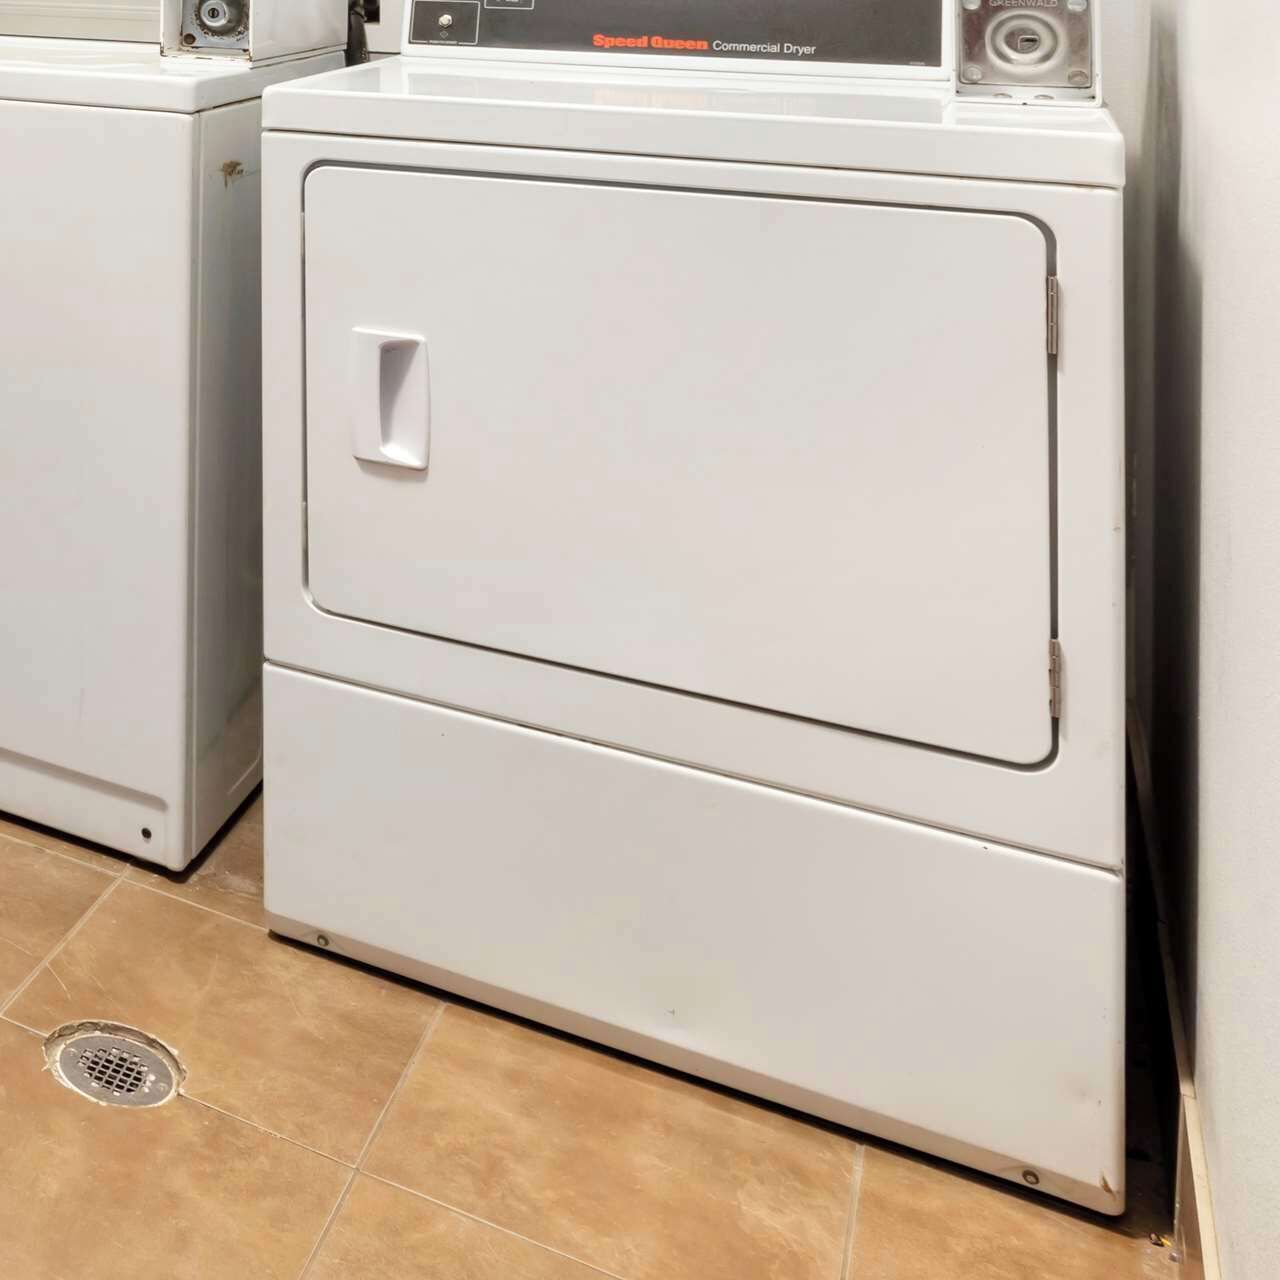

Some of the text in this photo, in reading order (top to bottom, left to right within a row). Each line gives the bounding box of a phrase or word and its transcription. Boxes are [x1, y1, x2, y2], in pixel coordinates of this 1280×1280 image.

[593, 34, 817, 57] Speed Queen Commercial Dryer
